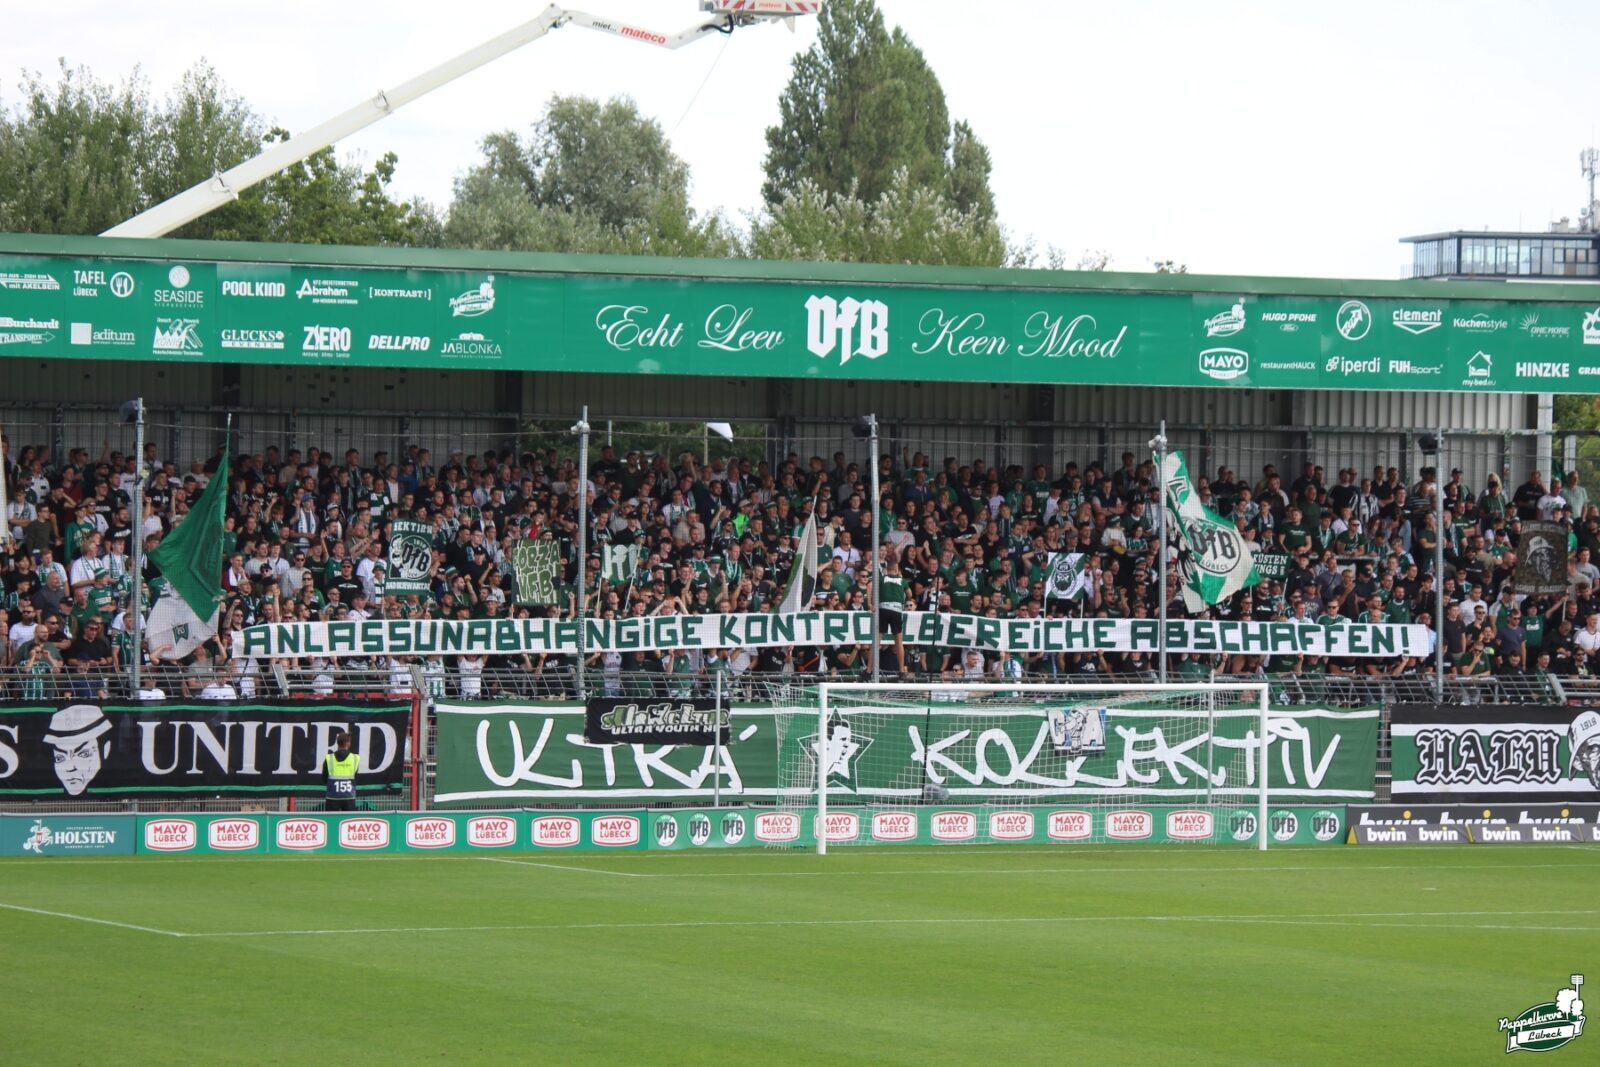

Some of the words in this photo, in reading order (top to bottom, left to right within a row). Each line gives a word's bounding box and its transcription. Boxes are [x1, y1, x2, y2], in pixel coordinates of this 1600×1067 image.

[620, 26, 666, 44] mateco
[73, 270, 107, 285] TAFEL
[73, 286, 98, 296] LÜBECK
[296, 278, 349, 299] Abraham
[154, 289, 204, 304] SEASIDE
[1262, 312, 1287, 322] HUGO
[1288, 313, 1318, 322] PFOHE
[1392, 308, 1442, 322] clement
[6, 317, 60, 329] Burchardt
[92, 328, 135, 342] aditum
[221, 329, 277, 341] GLÜCKS
[595, 304, 684, 351] Echt
[697, 303, 785, 352] Leev
[804, 294, 889, 366] VfB
[911, 307, 1010, 356] Keen
[1017, 310, 1128, 358] Mood
[368, 334, 431, 351] DELLPRO
[440, 343, 502, 354] JABLONKA
[1204, 354, 1244, 368] MAYO
[1340, 356, 1381, 376] iperdi
[1516, 362, 1570, 378] HINZKE
[1254, 552, 1288, 565] KÜSTEN
[1130, 620, 1410, 654] ABSCHAFFEN!
[334, 780, 352, 793] 155
[476, 822, 508, 830] MAYO
[540, 822, 572, 830] MAYO
[600, 821, 632, 830] MAYO
[762, 817, 792, 826] MAYO
[880, 817, 910, 826] MAYO
[938, 816, 969, 825] MAYO
[997, 816, 1026, 824] MAYO
[1056, 816, 1085, 824] MAYO
[1114, 816, 1145, 824] MAYO
[1174, 816, 1206, 824] MAYO
[1230, 817, 1254, 834] VfB
[1272, 817, 1296, 834] VfB
[1312, 817, 1337, 834] VfB
[154, 824, 188, 834] MAYO
[217, 824, 250, 833] MAYO
[285, 824, 319, 832] MAYO
[348, 824, 381, 832] MAYO
[414, 822, 447, 832] MAYO
[656, 822, 676, 840] VfB
[690, 820, 709, 838] VfB
[722, 820, 744, 838] VfB
[1418, 826, 1458, 841] bwin
[1482, 826, 1520, 840] bwin
[1532, 826, 1572, 840] bwin
[54, 831, 116, 844] HOLSTEN
[154, 834, 187, 842] LÜBECK
[217, 834, 250, 842] LÜBECK
[285, 833, 318, 841] LÜBECK
[1366, 826, 1407, 842] bwin
